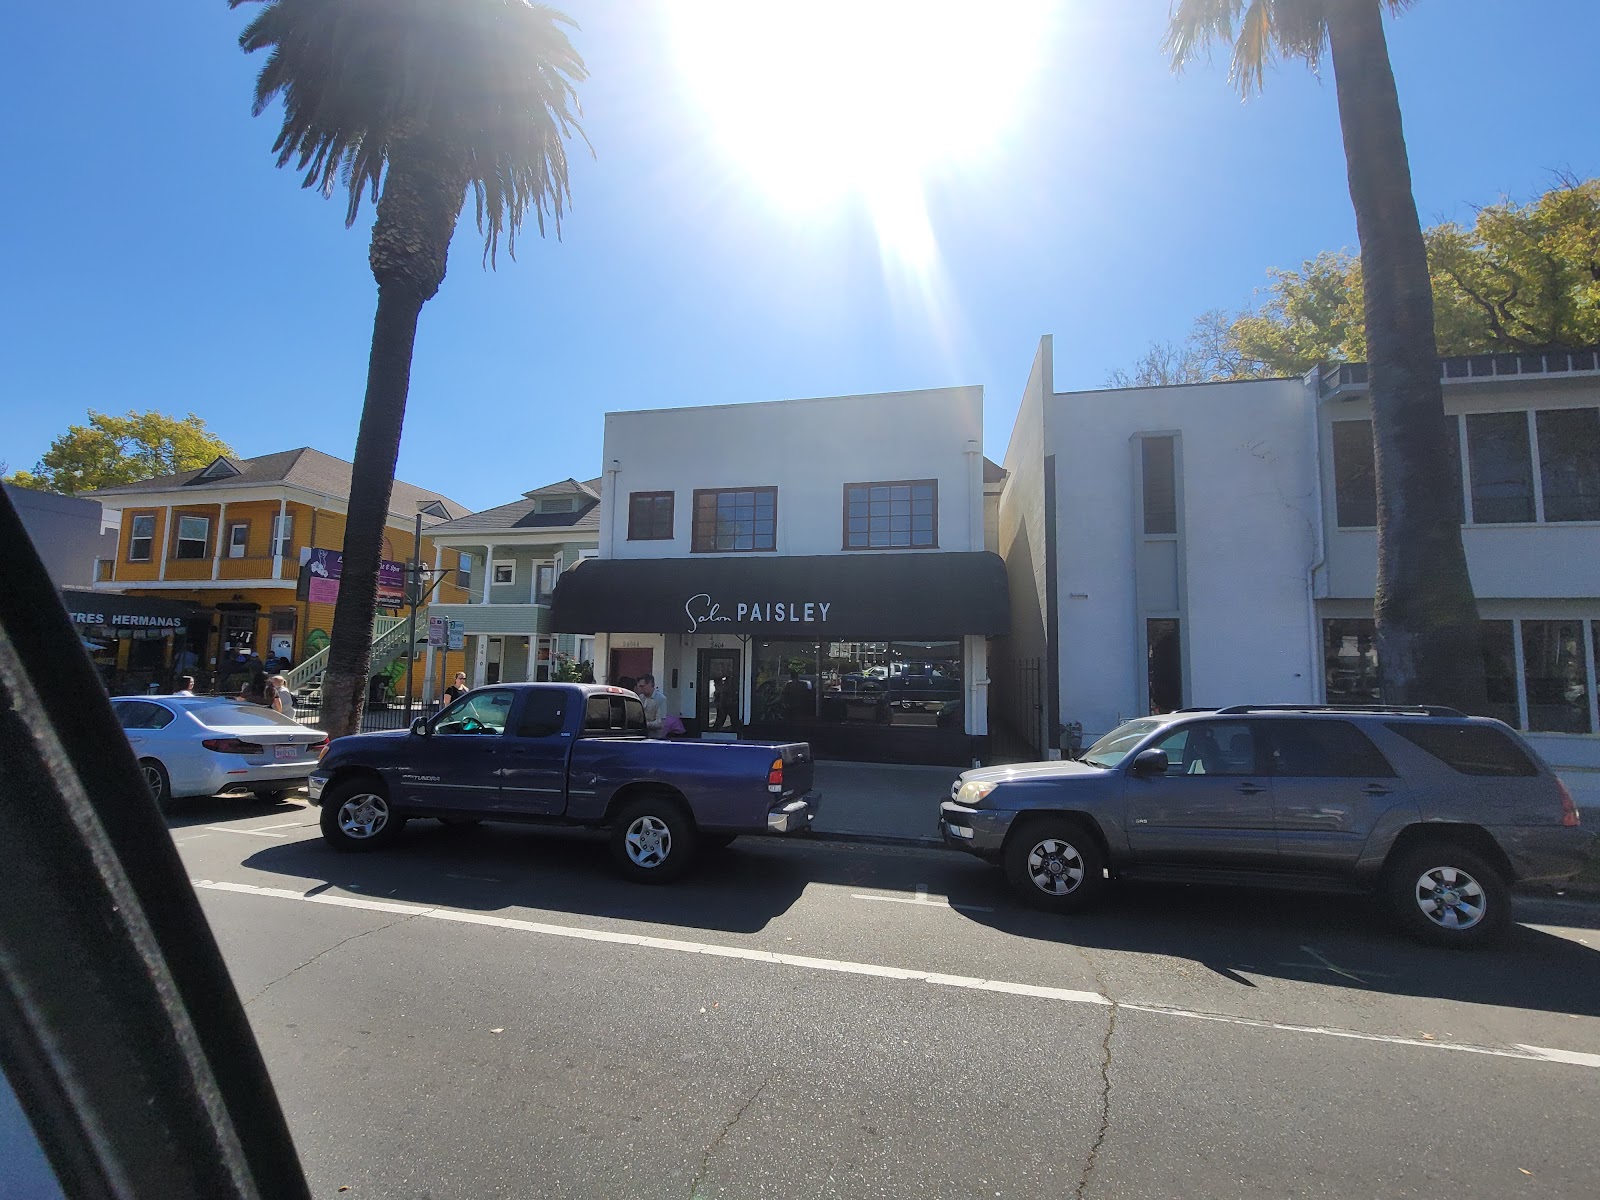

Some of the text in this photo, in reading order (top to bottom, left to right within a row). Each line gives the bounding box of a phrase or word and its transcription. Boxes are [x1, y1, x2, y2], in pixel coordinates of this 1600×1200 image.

[67, 612, 181, 627] TRES HERMANAS
[685, 593, 831, 634] Salon PAISLEY
